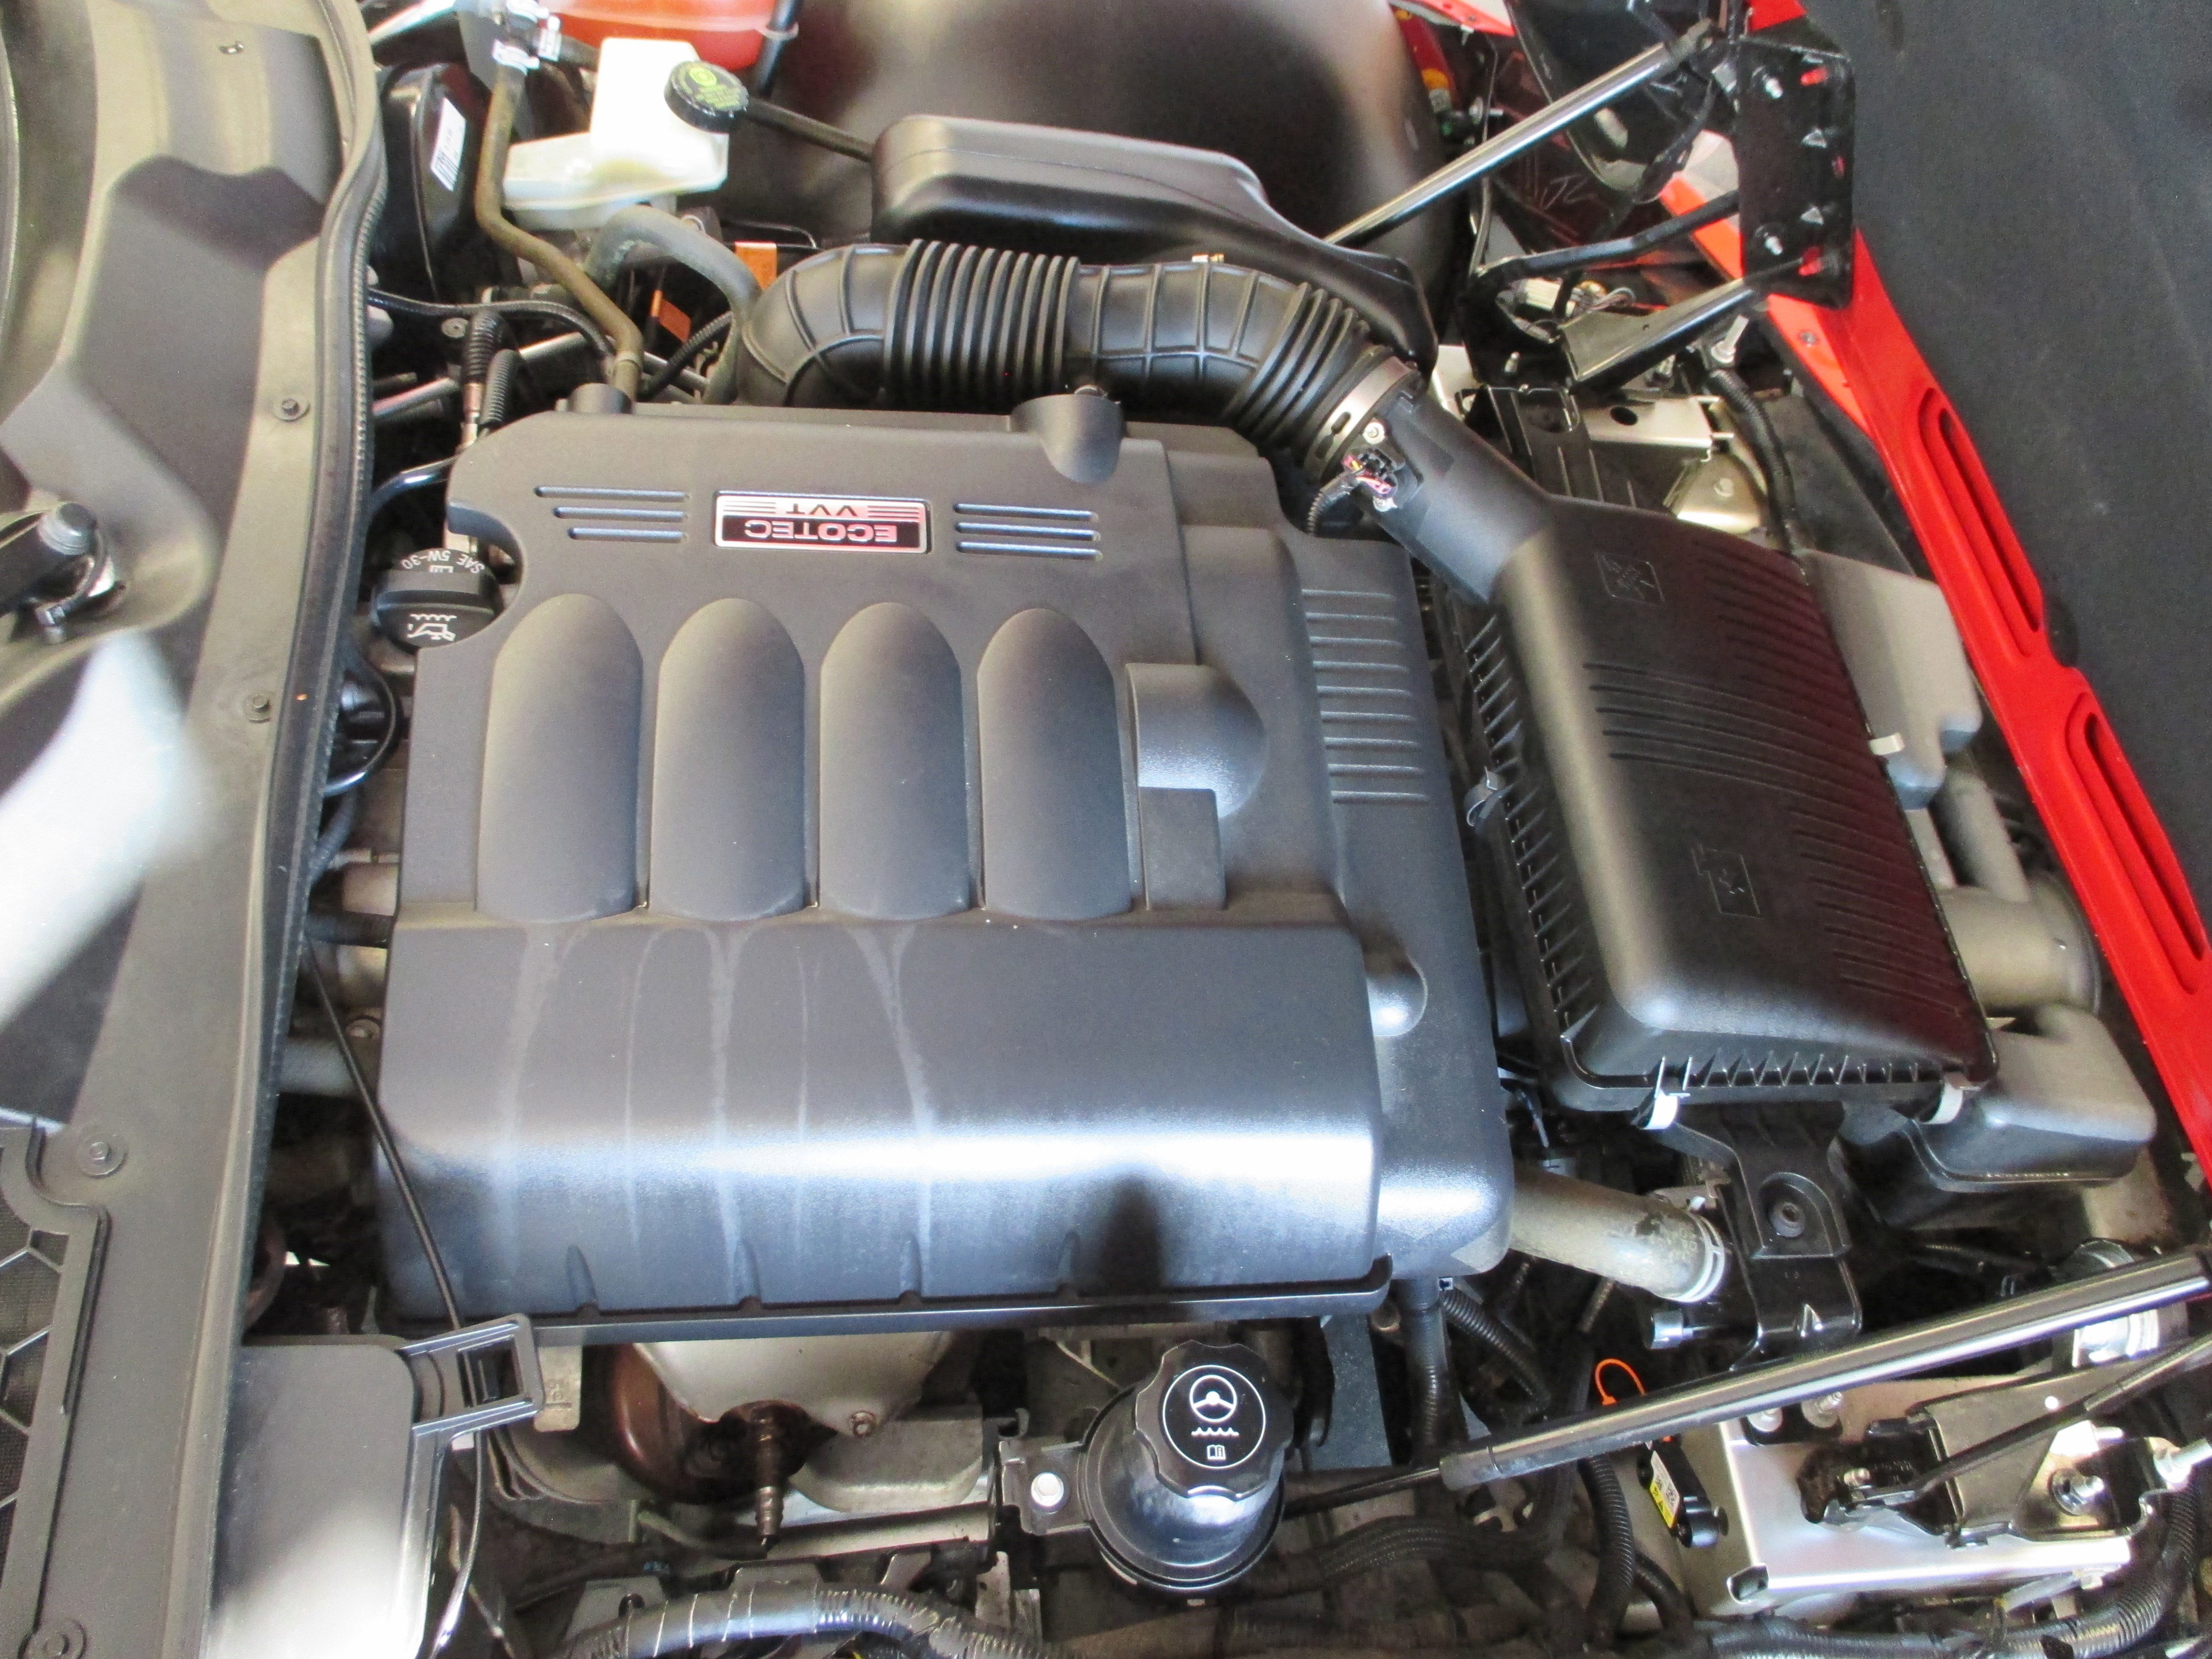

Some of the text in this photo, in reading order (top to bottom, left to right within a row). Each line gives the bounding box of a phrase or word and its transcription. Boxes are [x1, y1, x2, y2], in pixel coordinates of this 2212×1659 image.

[786, 503, 858, 517] VVT
[744, 519, 897, 543] ECOTEC
[401, 550, 485, 574] SAE 5W-30
